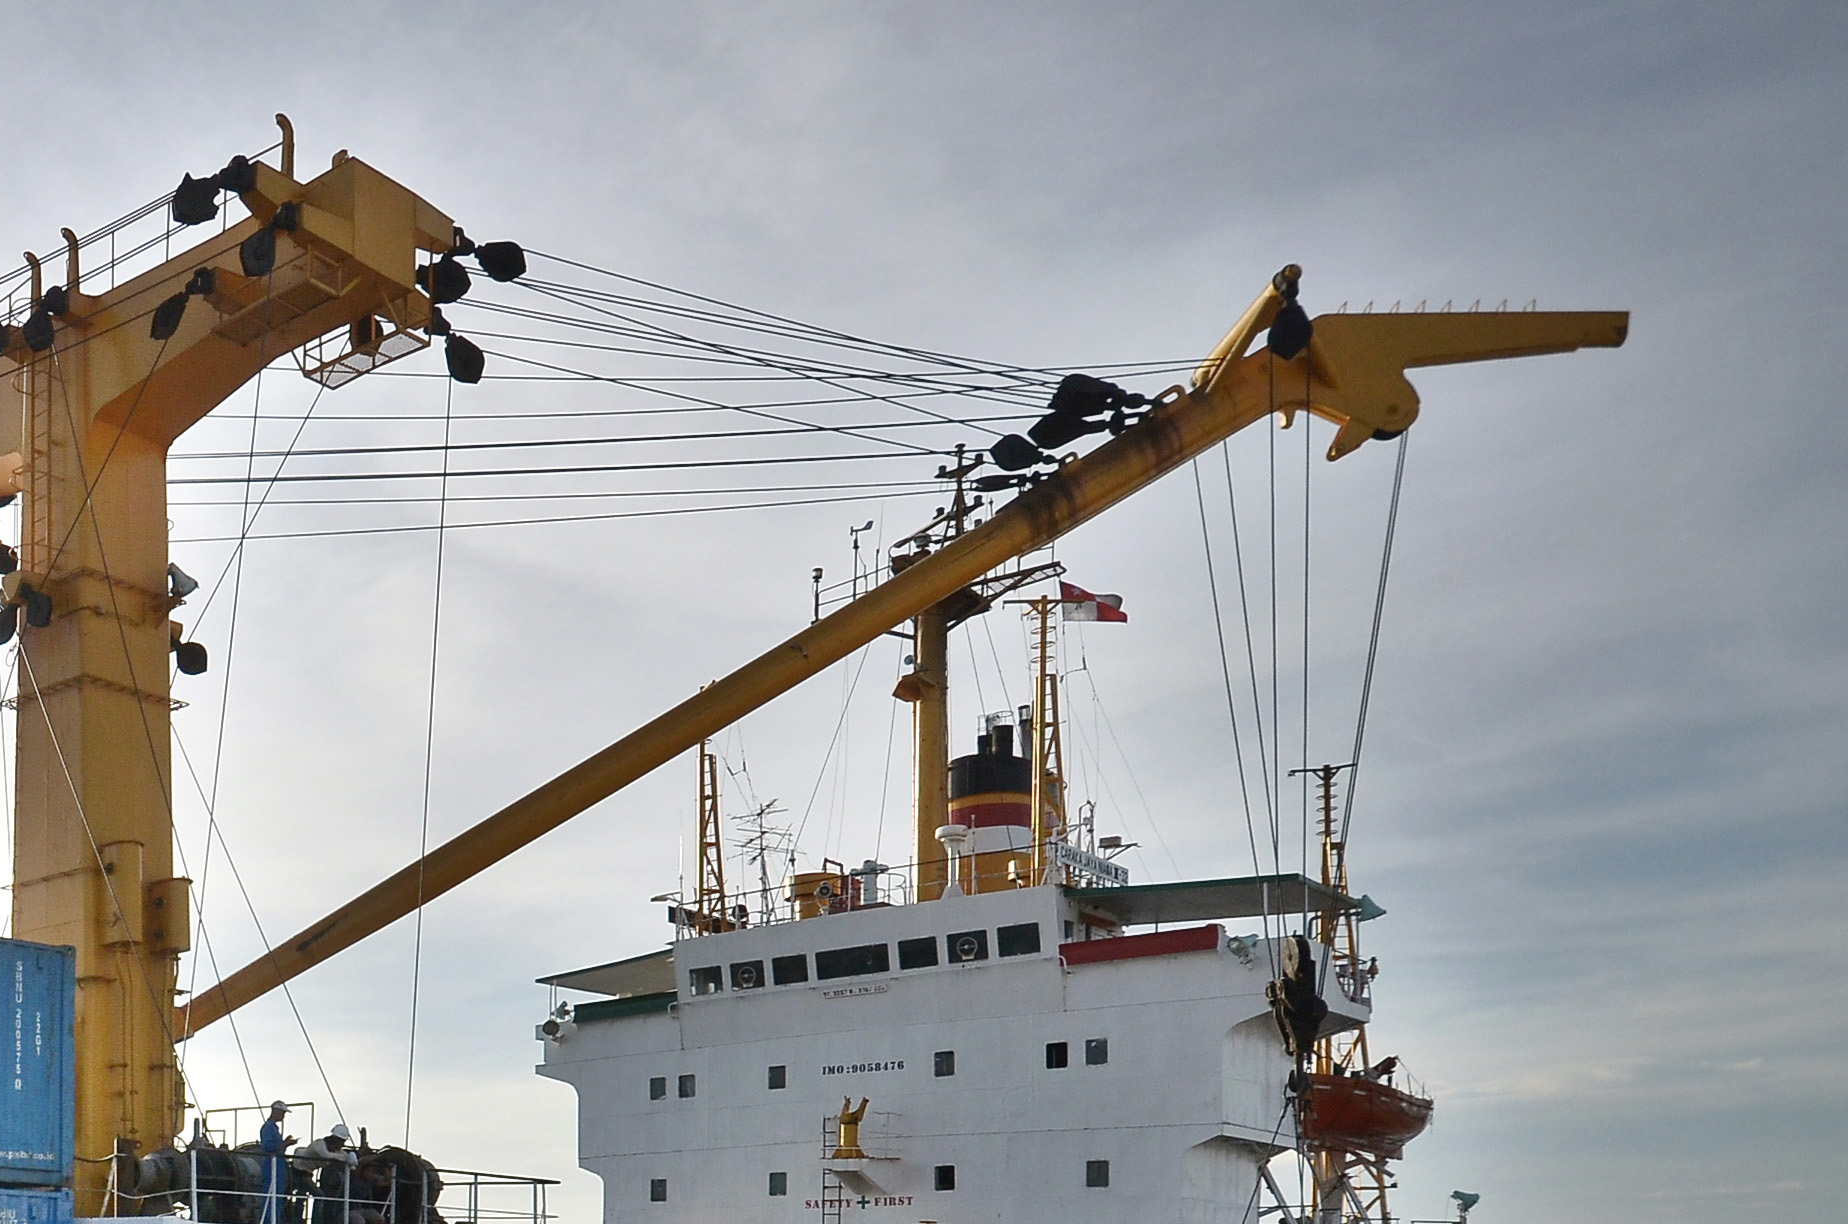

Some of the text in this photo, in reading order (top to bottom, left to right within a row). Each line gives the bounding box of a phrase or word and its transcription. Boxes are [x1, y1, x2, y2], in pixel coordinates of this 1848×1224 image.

[14, 960, 23, 1003] SBNU
[14, 1008, 22, 1075] 200575
[822, 1060, 905, 1075] IMO:9058476
[874, 1196, 914, 1207] FIRST
